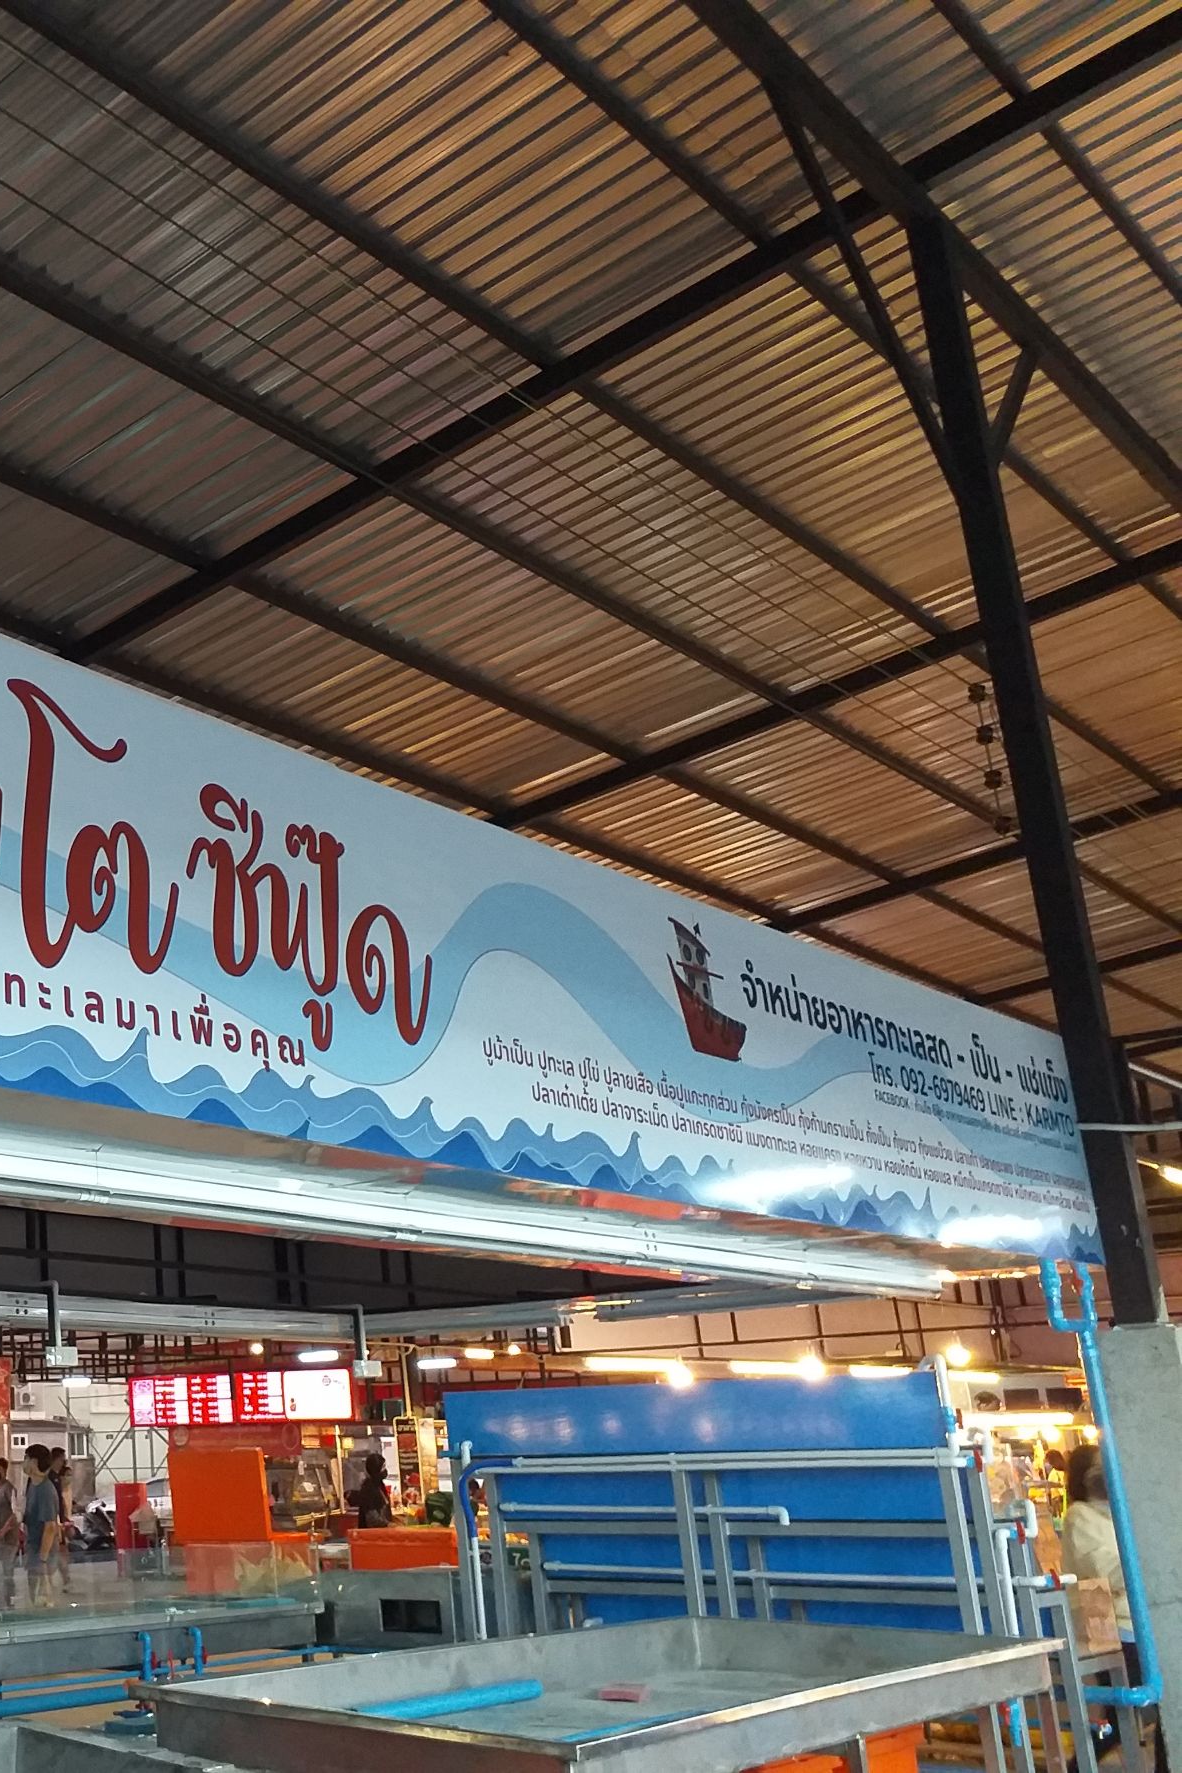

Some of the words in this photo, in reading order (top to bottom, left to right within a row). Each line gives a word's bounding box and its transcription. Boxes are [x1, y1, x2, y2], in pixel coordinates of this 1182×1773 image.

[740, 959, 953, 1069] จำหน่ายอาหารทะเลสด
[970, 1033, 1002, 1084] เป็น
[1017, 1056, 1068, 1104] แช่แข็ง
[482, 1035, 533, 1066] ปูม้าเป็น
[538, 1051, 575, 1078] ปูทะเล
[578, 1057, 600, 1087] ปูไข่
[604, 1067, 654, 1095] ปูลายเสือ
[532, 1082, 598, 1114] ปลาเต๋าเต้ย
[601, 1097, 669, 1129] ปลาจาระเม็ด
[900, 1066, 986, 1112] 092-6979469
[1025, 1102, 1076, 1137] KARMTO
